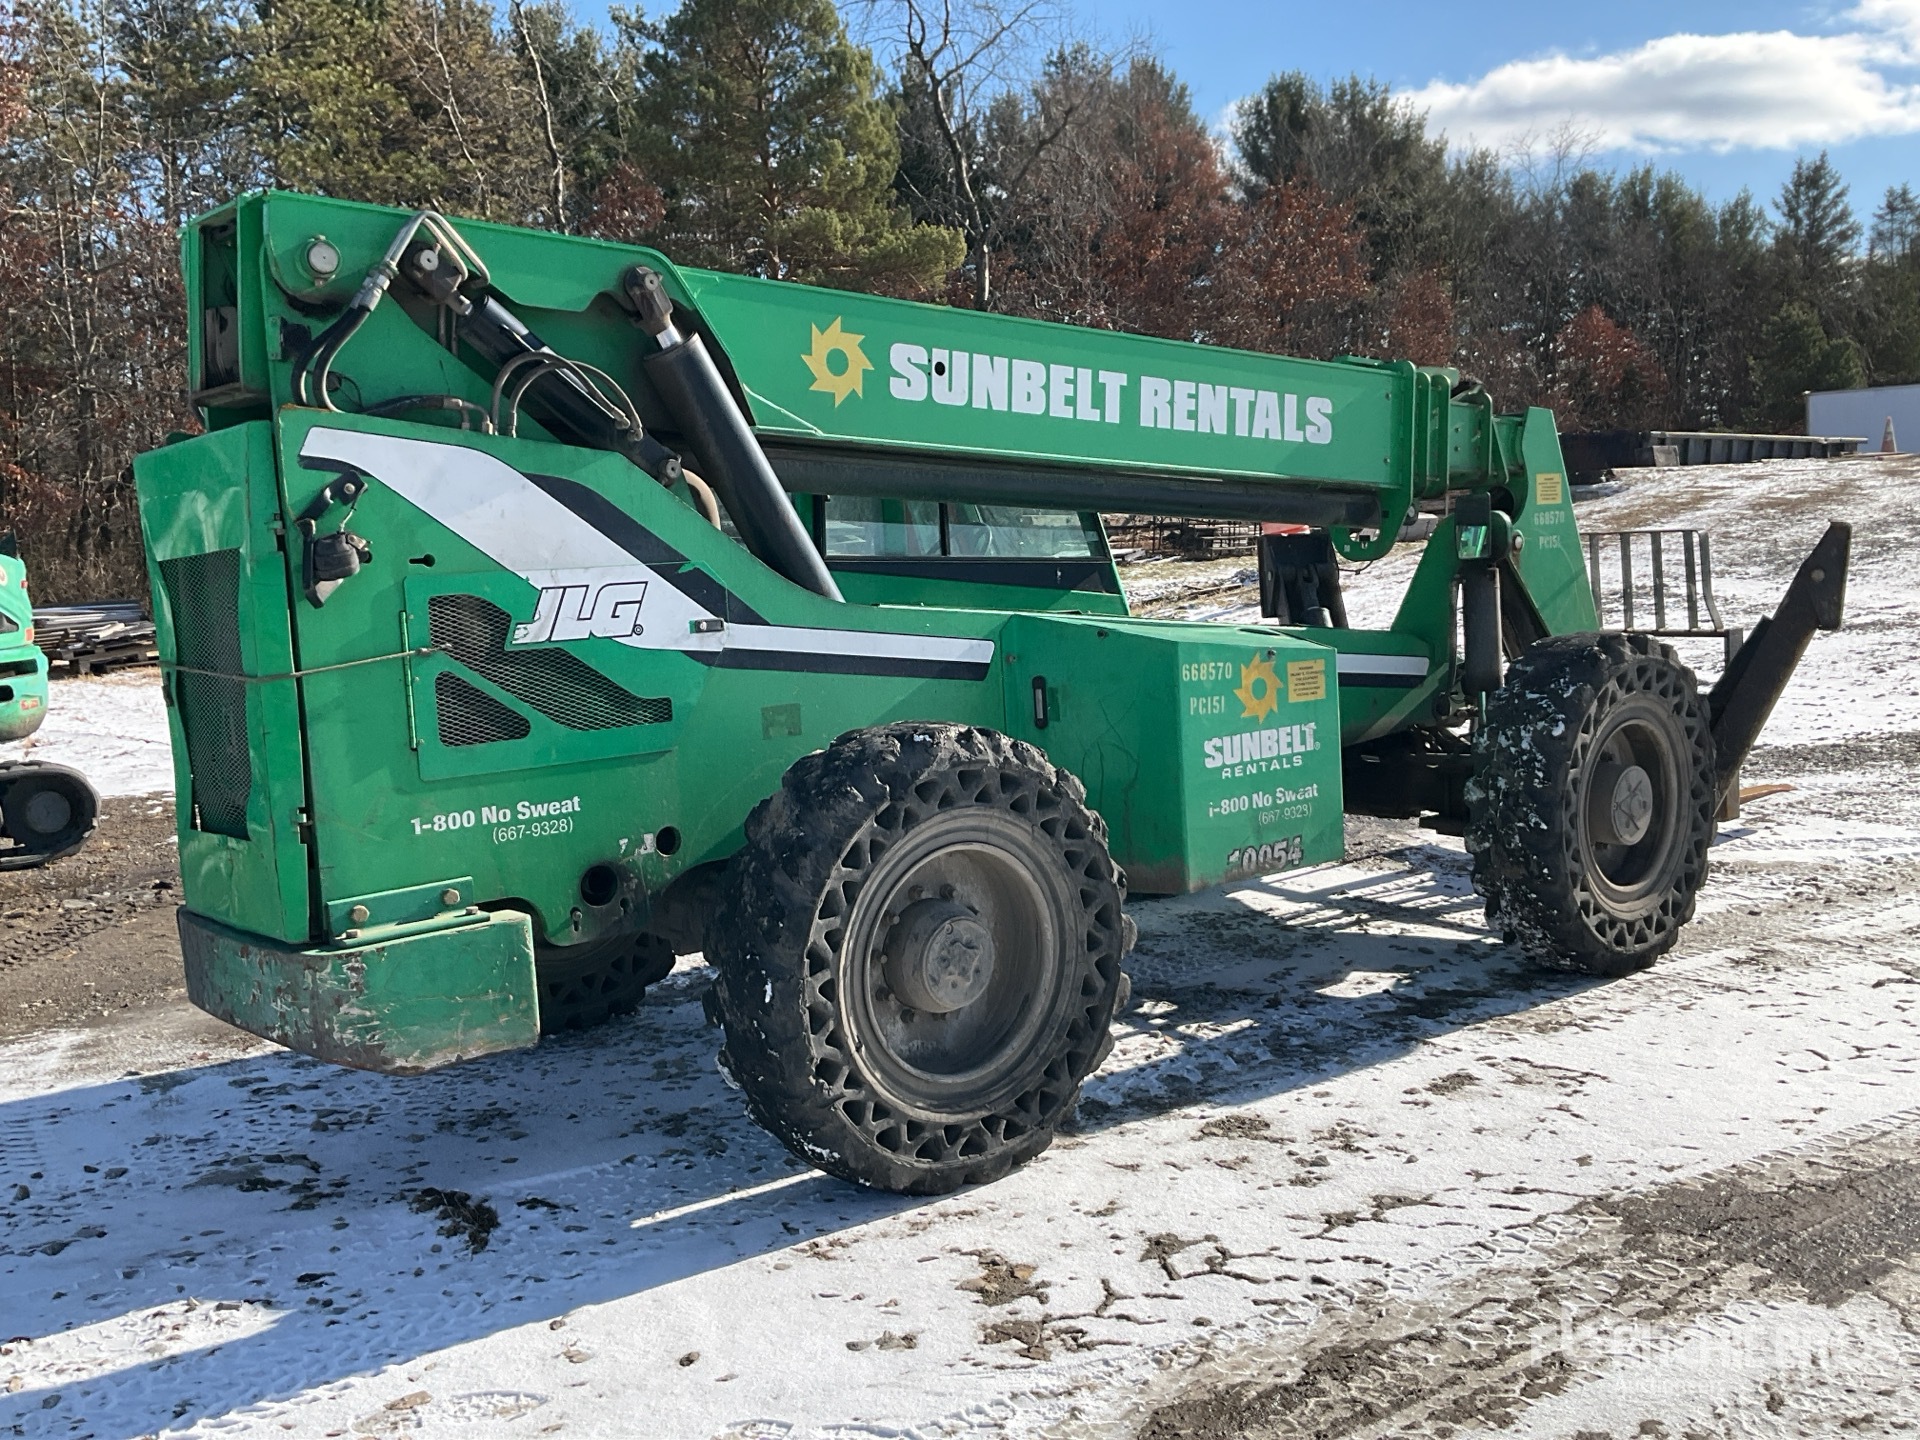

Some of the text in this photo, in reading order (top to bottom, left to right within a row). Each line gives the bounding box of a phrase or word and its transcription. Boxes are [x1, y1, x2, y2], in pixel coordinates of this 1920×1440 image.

[889, 342, 1334, 445] SUNBELT RENTALS
[1534, 511, 1565, 525] 668570
[511, 581, 649, 644] JLG
[1182, 661, 1232, 681] 668570
[1203, 721, 1317, 769] SUNBELT
[1221, 754, 1303, 779] RENTALS
[1252, 791, 1272, 809] No
[1275, 783, 1319, 804] Sweat
[410, 795, 581, 835] 1-800 No Sweat
[492, 816, 574, 844] (667-9328)
